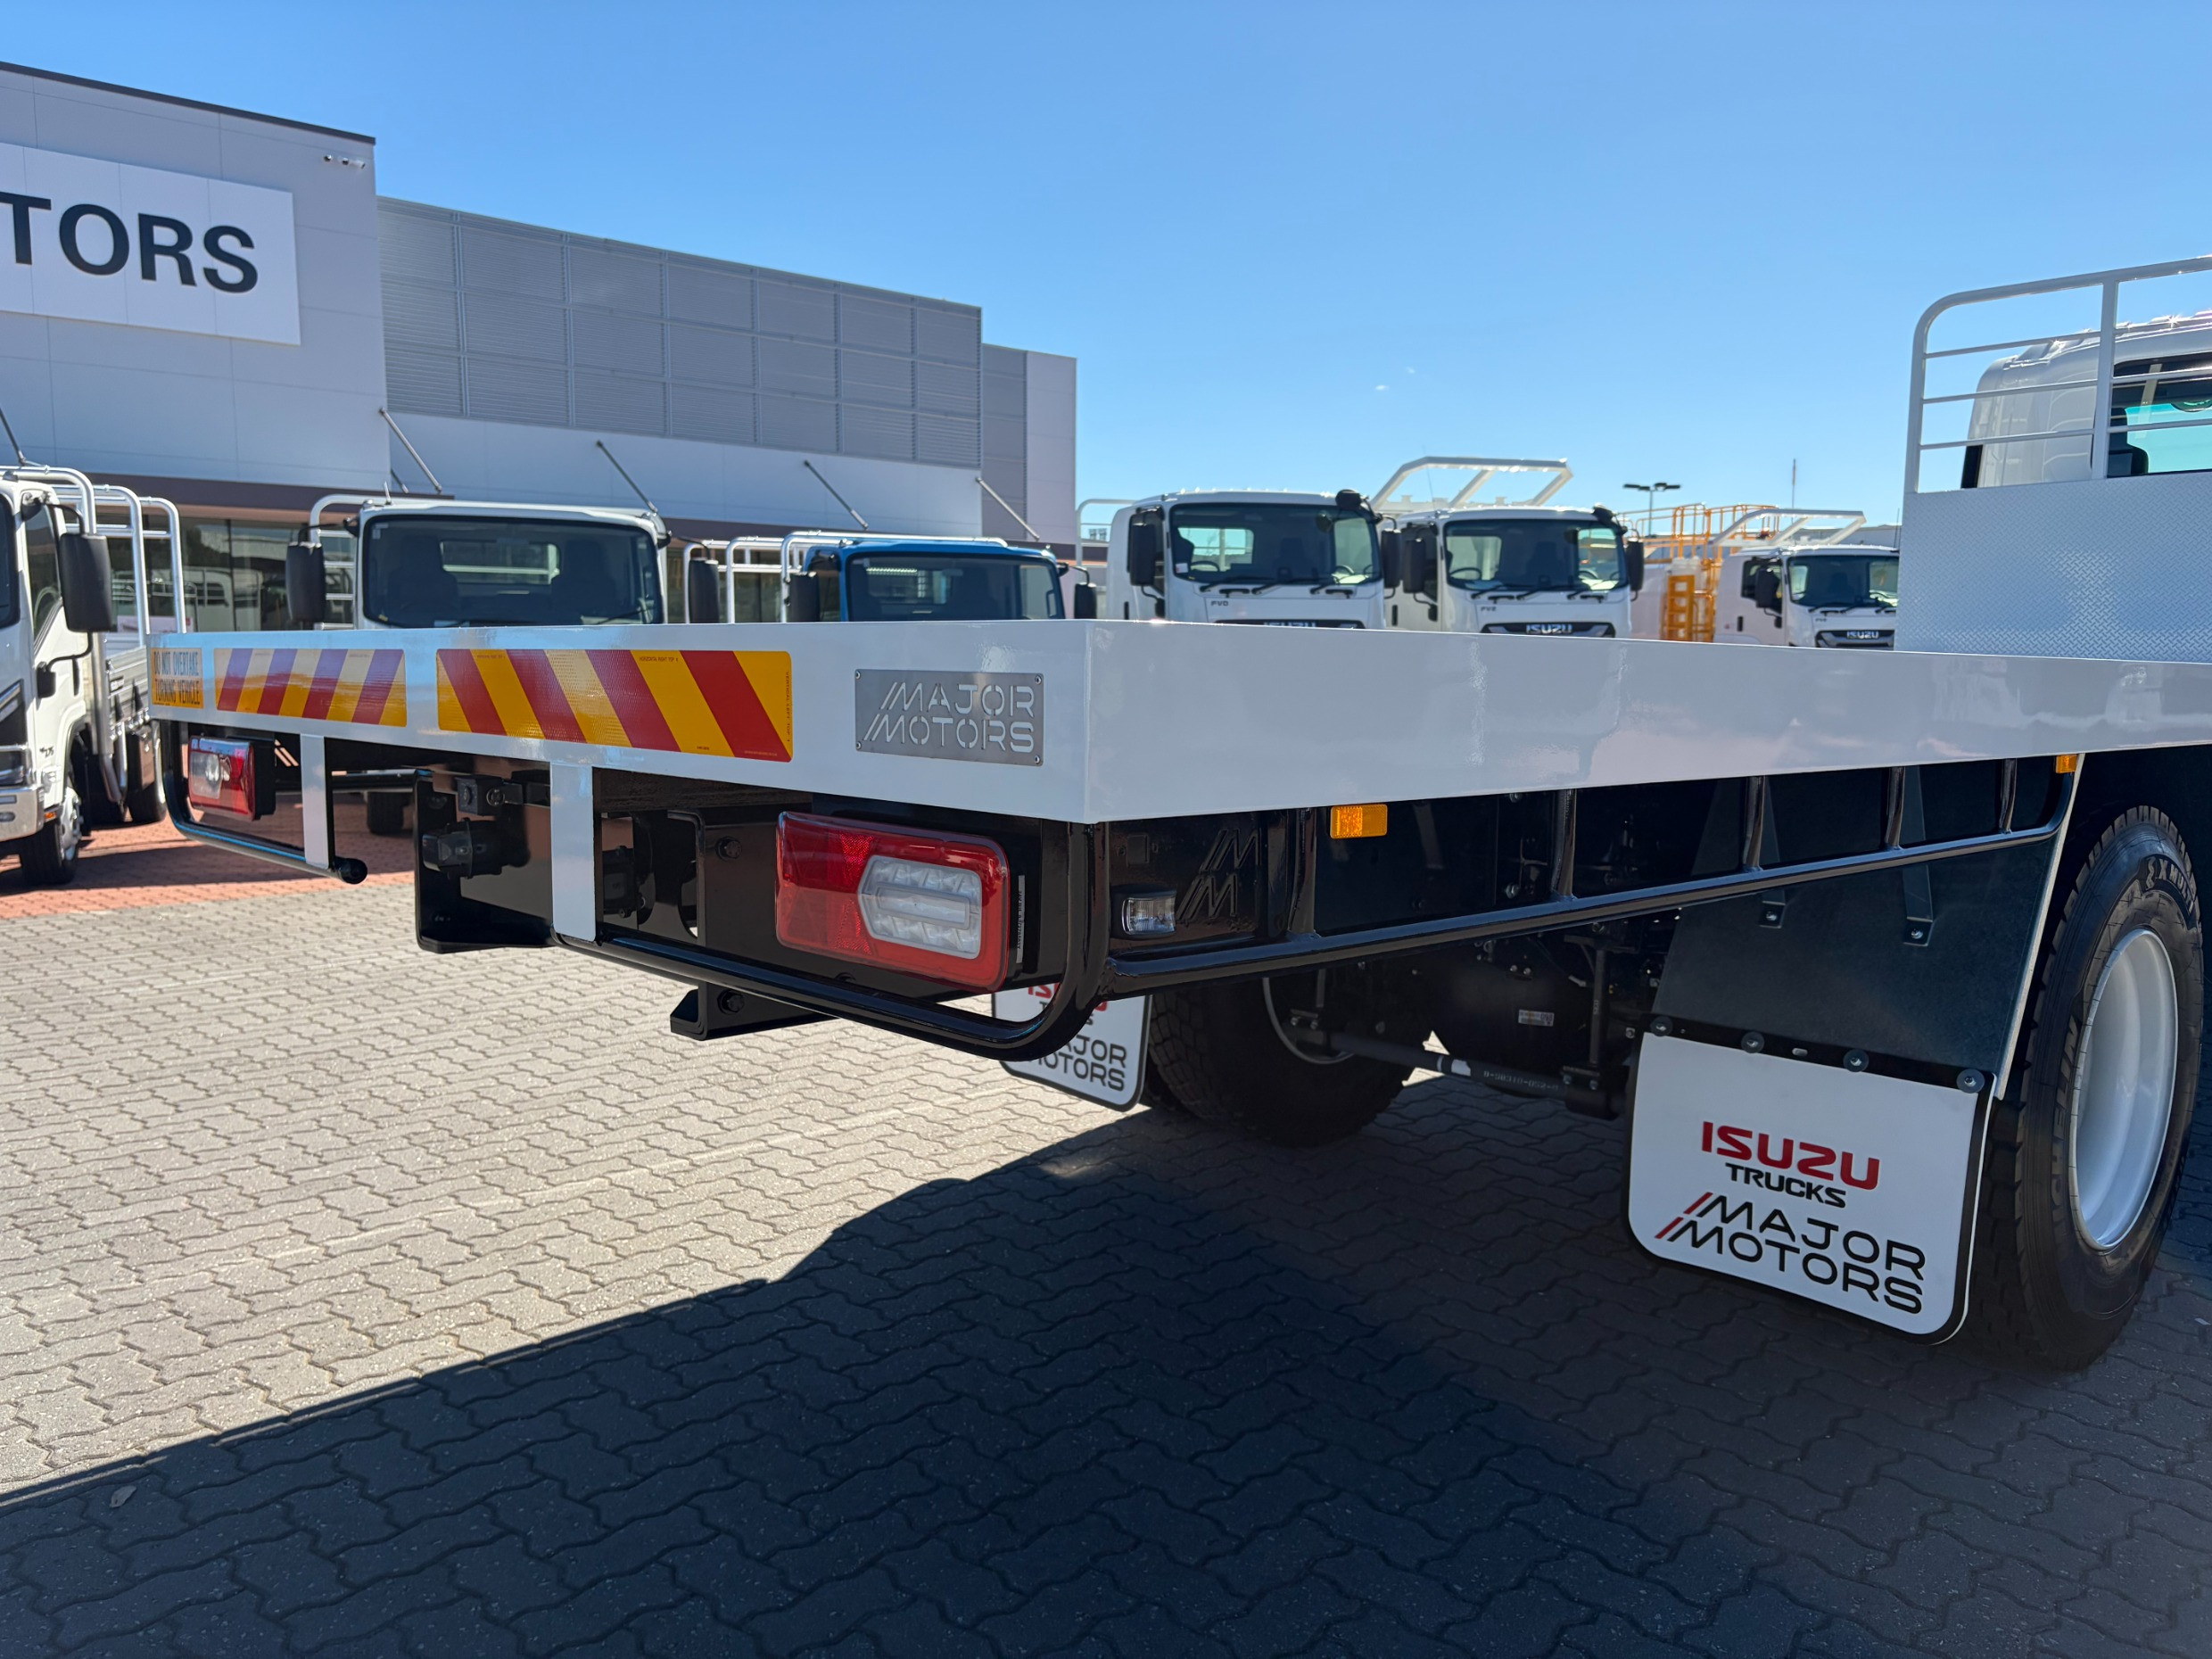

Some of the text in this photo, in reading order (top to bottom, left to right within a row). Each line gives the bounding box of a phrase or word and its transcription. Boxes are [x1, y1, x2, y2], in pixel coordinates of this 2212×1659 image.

[0, 192, 259, 293] TORS
[1525, 623, 1573, 634] ISUZU
[887, 681, 1035, 717] MAJOR
[871, 713, 1035, 754] MOTORS
[1028, 1051, 1126, 1092] OTORS
[1065, 1034, 1127, 1069] JOR
[1701, 1120, 1880, 1191] ISUZU
[1725, 1162, 1847, 1209] TRUCKS
[1695, 1193, 1926, 1281] MAJOR
[1665, 1218, 1923, 1315] MOTORS
